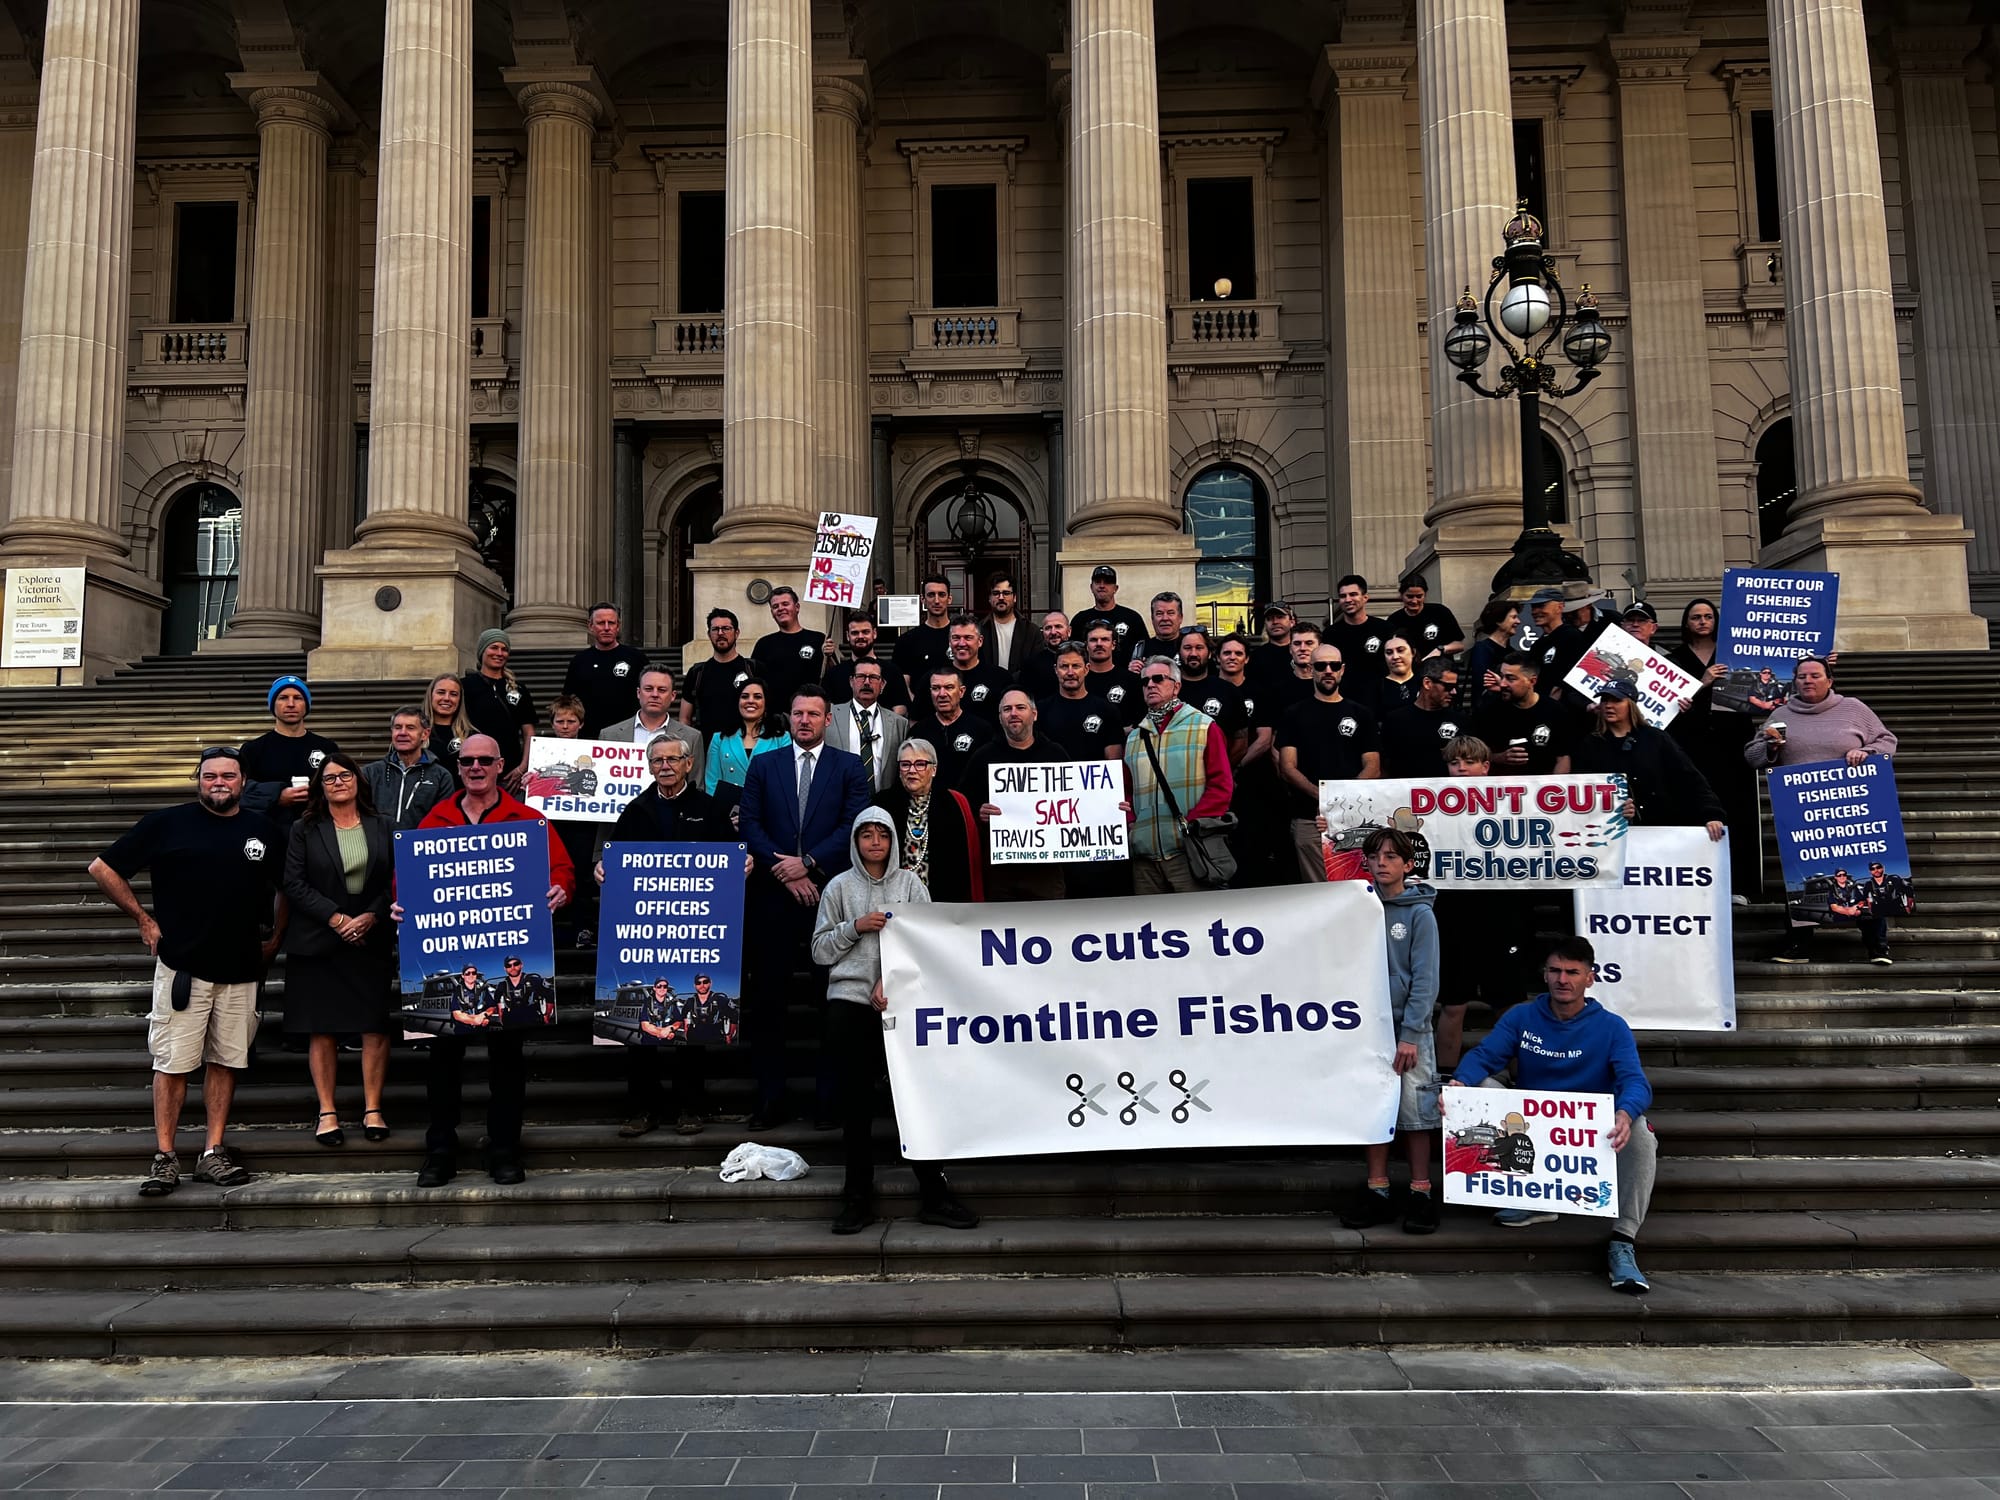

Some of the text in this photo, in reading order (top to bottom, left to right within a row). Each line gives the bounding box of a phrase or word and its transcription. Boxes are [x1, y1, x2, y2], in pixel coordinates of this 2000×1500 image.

[823, 513, 841, 527] NO
[814, 532, 872, 557] FISHERIES
[815, 557, 832, 574] NO
[18, 576, 53, 586] Explore
[18, 585, 60, 594] Victorian
[809, 578, 855, 603] FISH
[1736, 577, 1824, 591] PROTECT OUR
[17, 595, 62, 604] landmark
[1745, 594, 1811, 608] FISHERIES
[1746, 611, 1807, 625] OFFICERS
[1731, 627, 1821, 642] WHO PROTECT
[1733, 644, 1760, 656] OUR
[1645, 656, 1690, 690] DON'T
[1648, 680, 1679, 703] GUT
[1638, 691, 1666, 716] OUR
[591, 746, 645, 761] DON'T
[609, 765, 644, 779] GUT
[993, 764, 1114, 793] SAVE THE VFA
[1783, 764, 1877, 786] PROTECT OUR
[604, 783, 642, 797] OUR
[1410, 784, 1617, 816] DON'T GUT
[1797, 784, 1869, 804] FISHERIES
[542, 797, 629, 814] Fisherie
[1035, 798, 1080, 825] SACK
[1803, 803, 1870, 822] OFFICERS
[992, 824, 1123, 848] TRAVIS DOWLING
[1474, 817, 1554, 848] OUR
[1791, 820, 1888, 843] WHO PROTECT
[413, 832, 528, 856] PROTECT OUR
[1799, 840, 1888, 861] OUR WATERS
[622, 853, 729, 869] PROTECT OUR
[992, 852, 1003, 861] HE
[1005, 850, 1037, 860] STINKS
[1039, 851, 1049, 859] OF
[1053, 849, 1091, 859] ROTTING
[1095, 849, 1115, 858] FISH
[1414, 851, 1429, 859] ATE
[1433, 849, 1599, 880] Fisheries
[428, 857, 515, 879] FISHERIES
[1623, 866, 1712, 887] ERIES
[433, 882, 513, 903] OFFICERS
[633, 877, 714, 892] FISHERIES
[415, 904, 533, 930] WHO PROTECT
[635, 900, 710, 915] OFFICERS
[616, 924, 727, 939] WHO PROTECT
[1589, 914, 1711, 935] ROTECT
[422, 929, 529, 954] OUR WATERS
[980, 918, 1265, 966] No cuts to
[619, 948, 720, 963] OUR WATERS
[914, 993, 1362, 1047] Frontline Fishos
[1522, 1030, 1543, 1045] Nick
[1520, 1041, 1582, 1058] McGowan MP
[1523, 1098, 1597, 1120] DON'T
[1549, 1127, 1597, 1148] GUT
[1544, 1154, 1598, 1175] OUR
[1465, 1172, 1600, 1203] Fisheries
